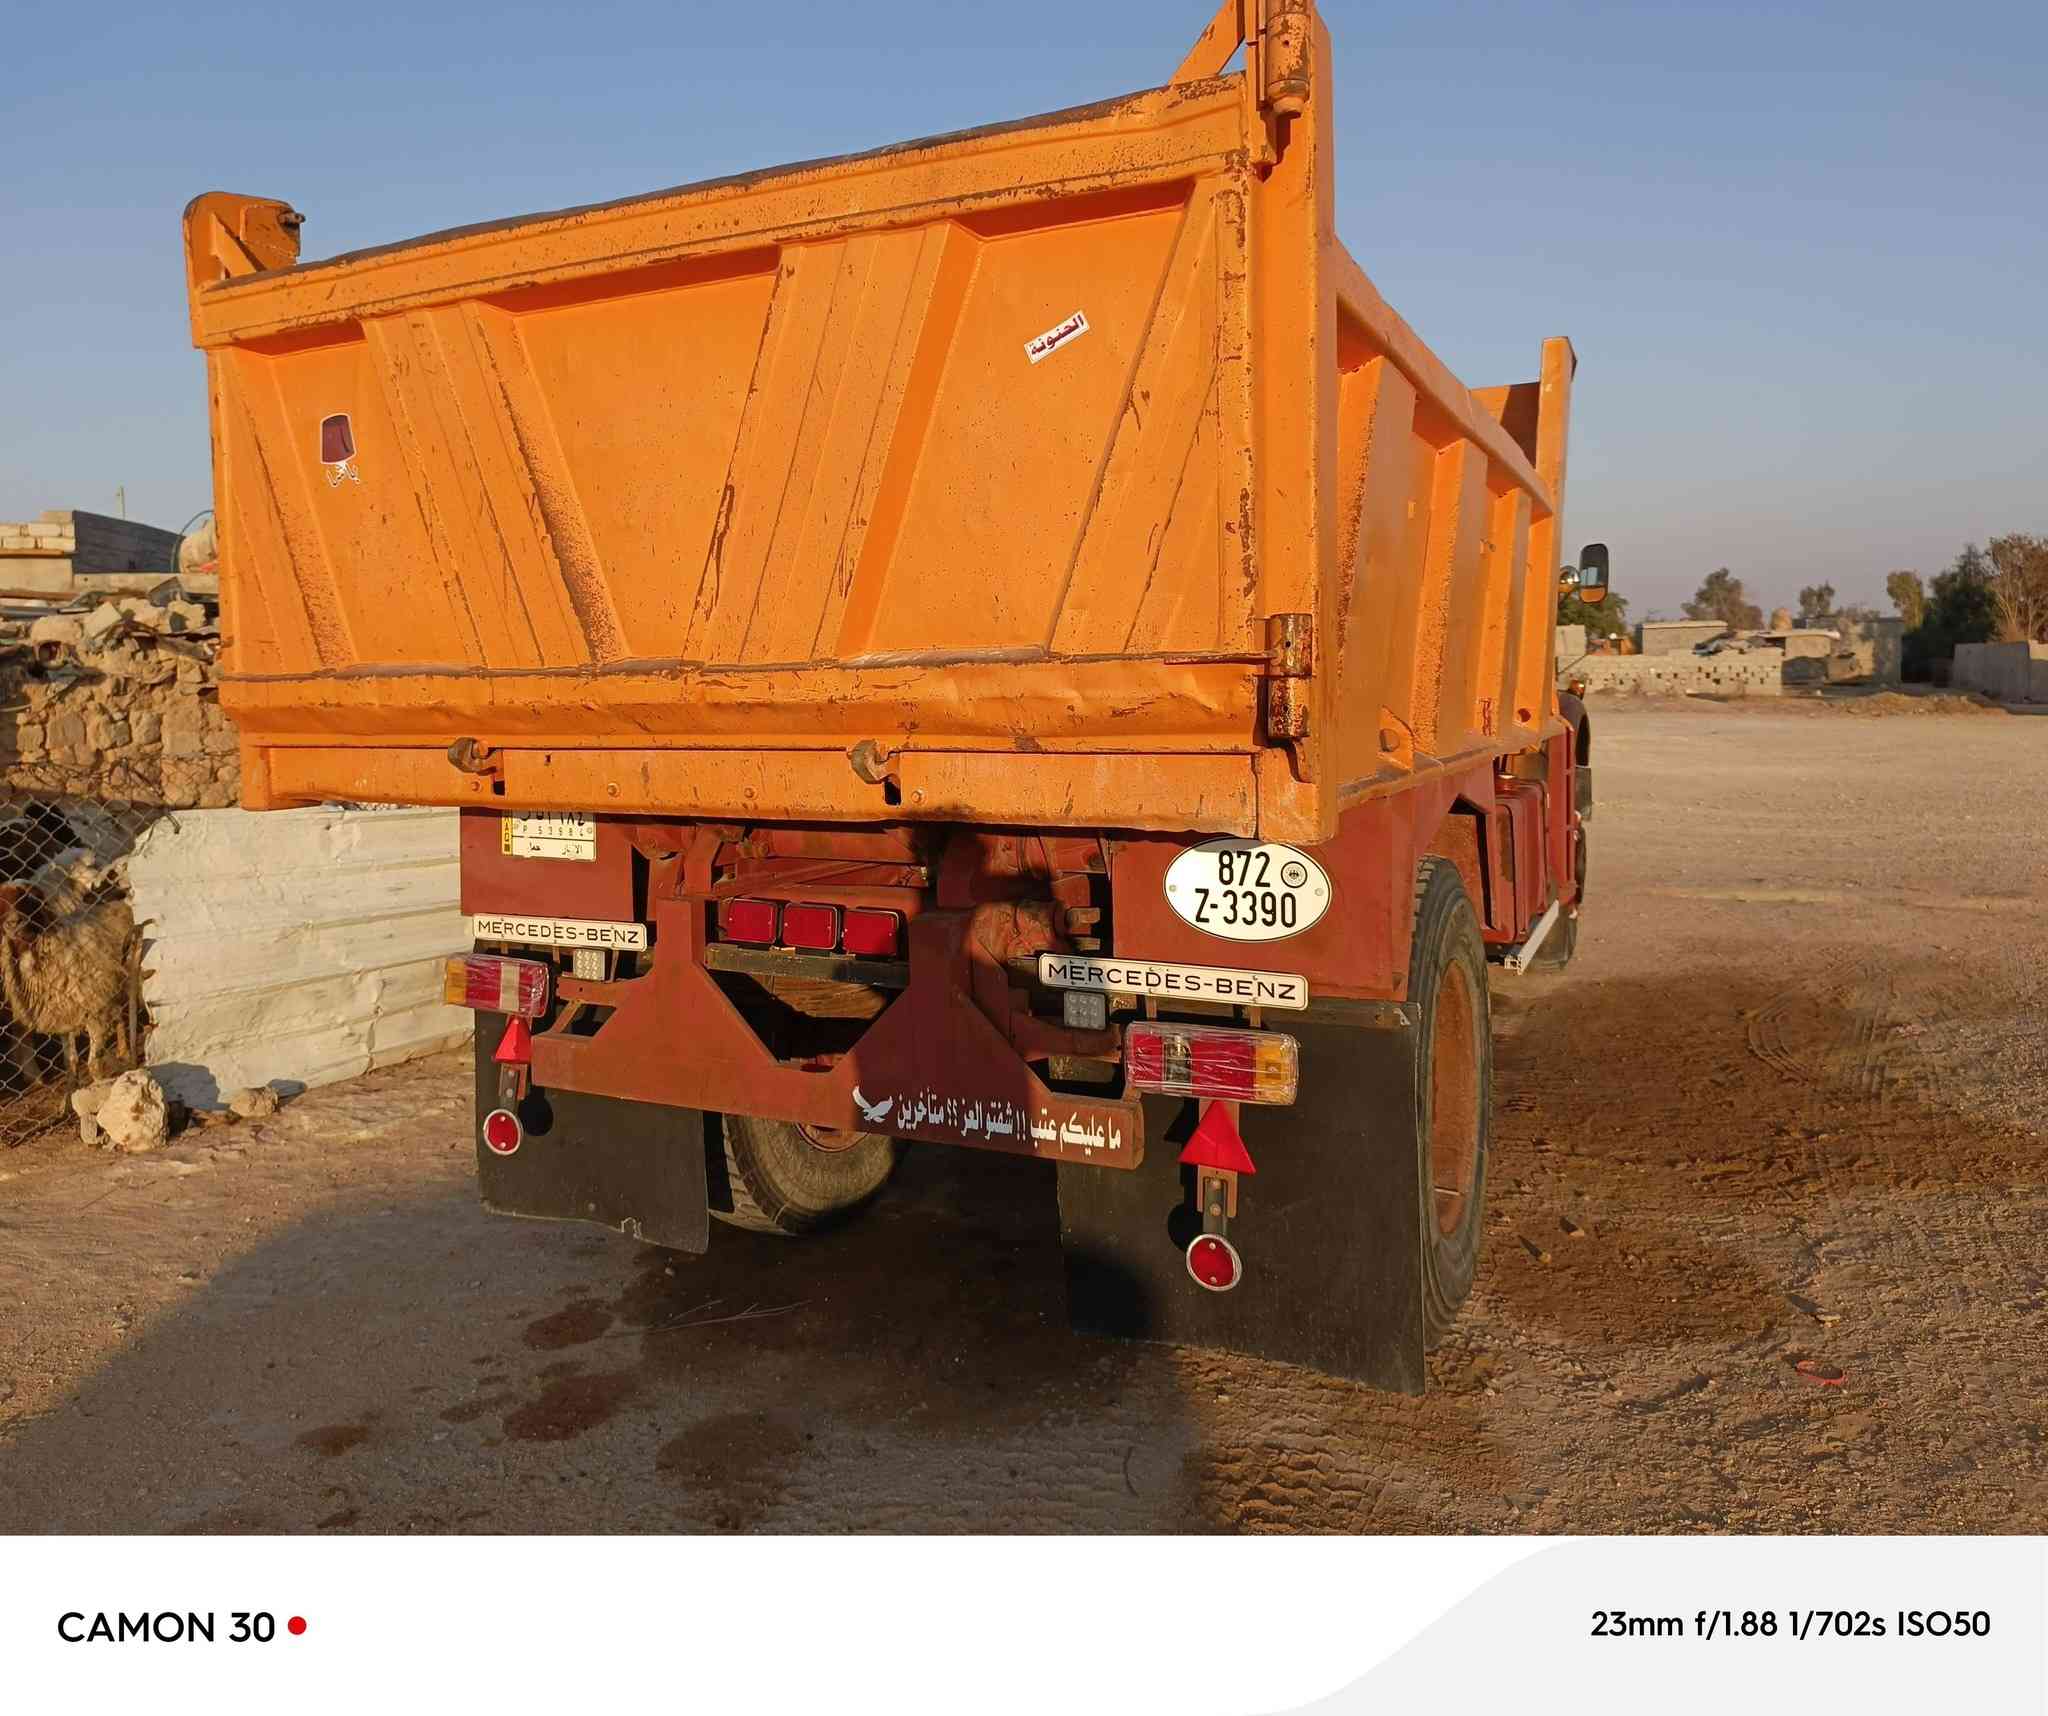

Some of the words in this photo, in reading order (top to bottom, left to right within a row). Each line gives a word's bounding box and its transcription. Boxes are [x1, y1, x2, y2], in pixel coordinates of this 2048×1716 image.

[1218, 850, 1271, 888] 872
[1195, 888, 1297, 928] Z-3390
[478, 920, 640, 944] MERCEDES-BENZ
[1048, 962, 1296, 1000] MERCEDES-BENZ
[1030, 1106, 1057, 1148] عتب
[1060, 1111, 1105, 1156] عليكم
[1108, 1115, 1122, 1150] ما
